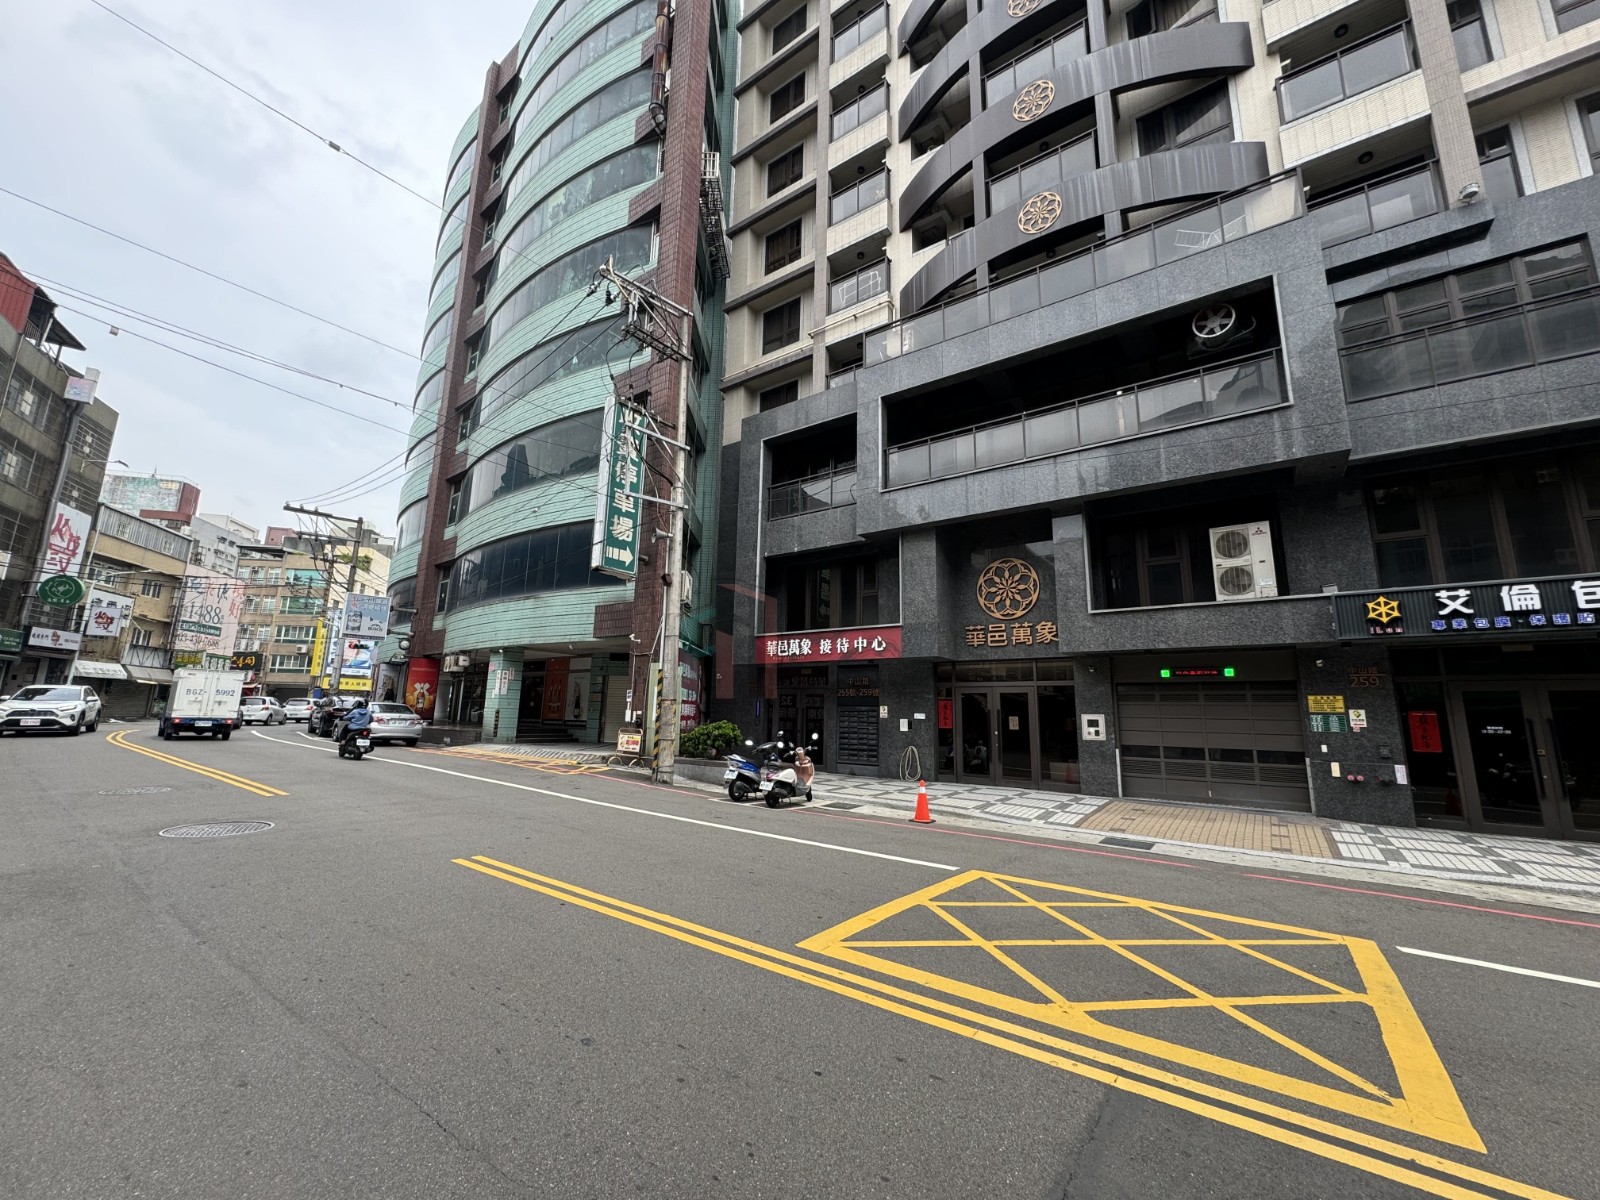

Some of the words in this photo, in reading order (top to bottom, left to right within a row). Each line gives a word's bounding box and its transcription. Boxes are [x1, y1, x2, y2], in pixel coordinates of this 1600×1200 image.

[1435, 580, 1600, 616] 艾倫包
[965, 621, 1059, 648] 華邑萬象
[766, 638, 812, 656] 華邑萬象
[819, 635, 887, 654] 接待中心
[215, 689, 236, 697] 5992
[1350, 677, 1380, 688] 259
